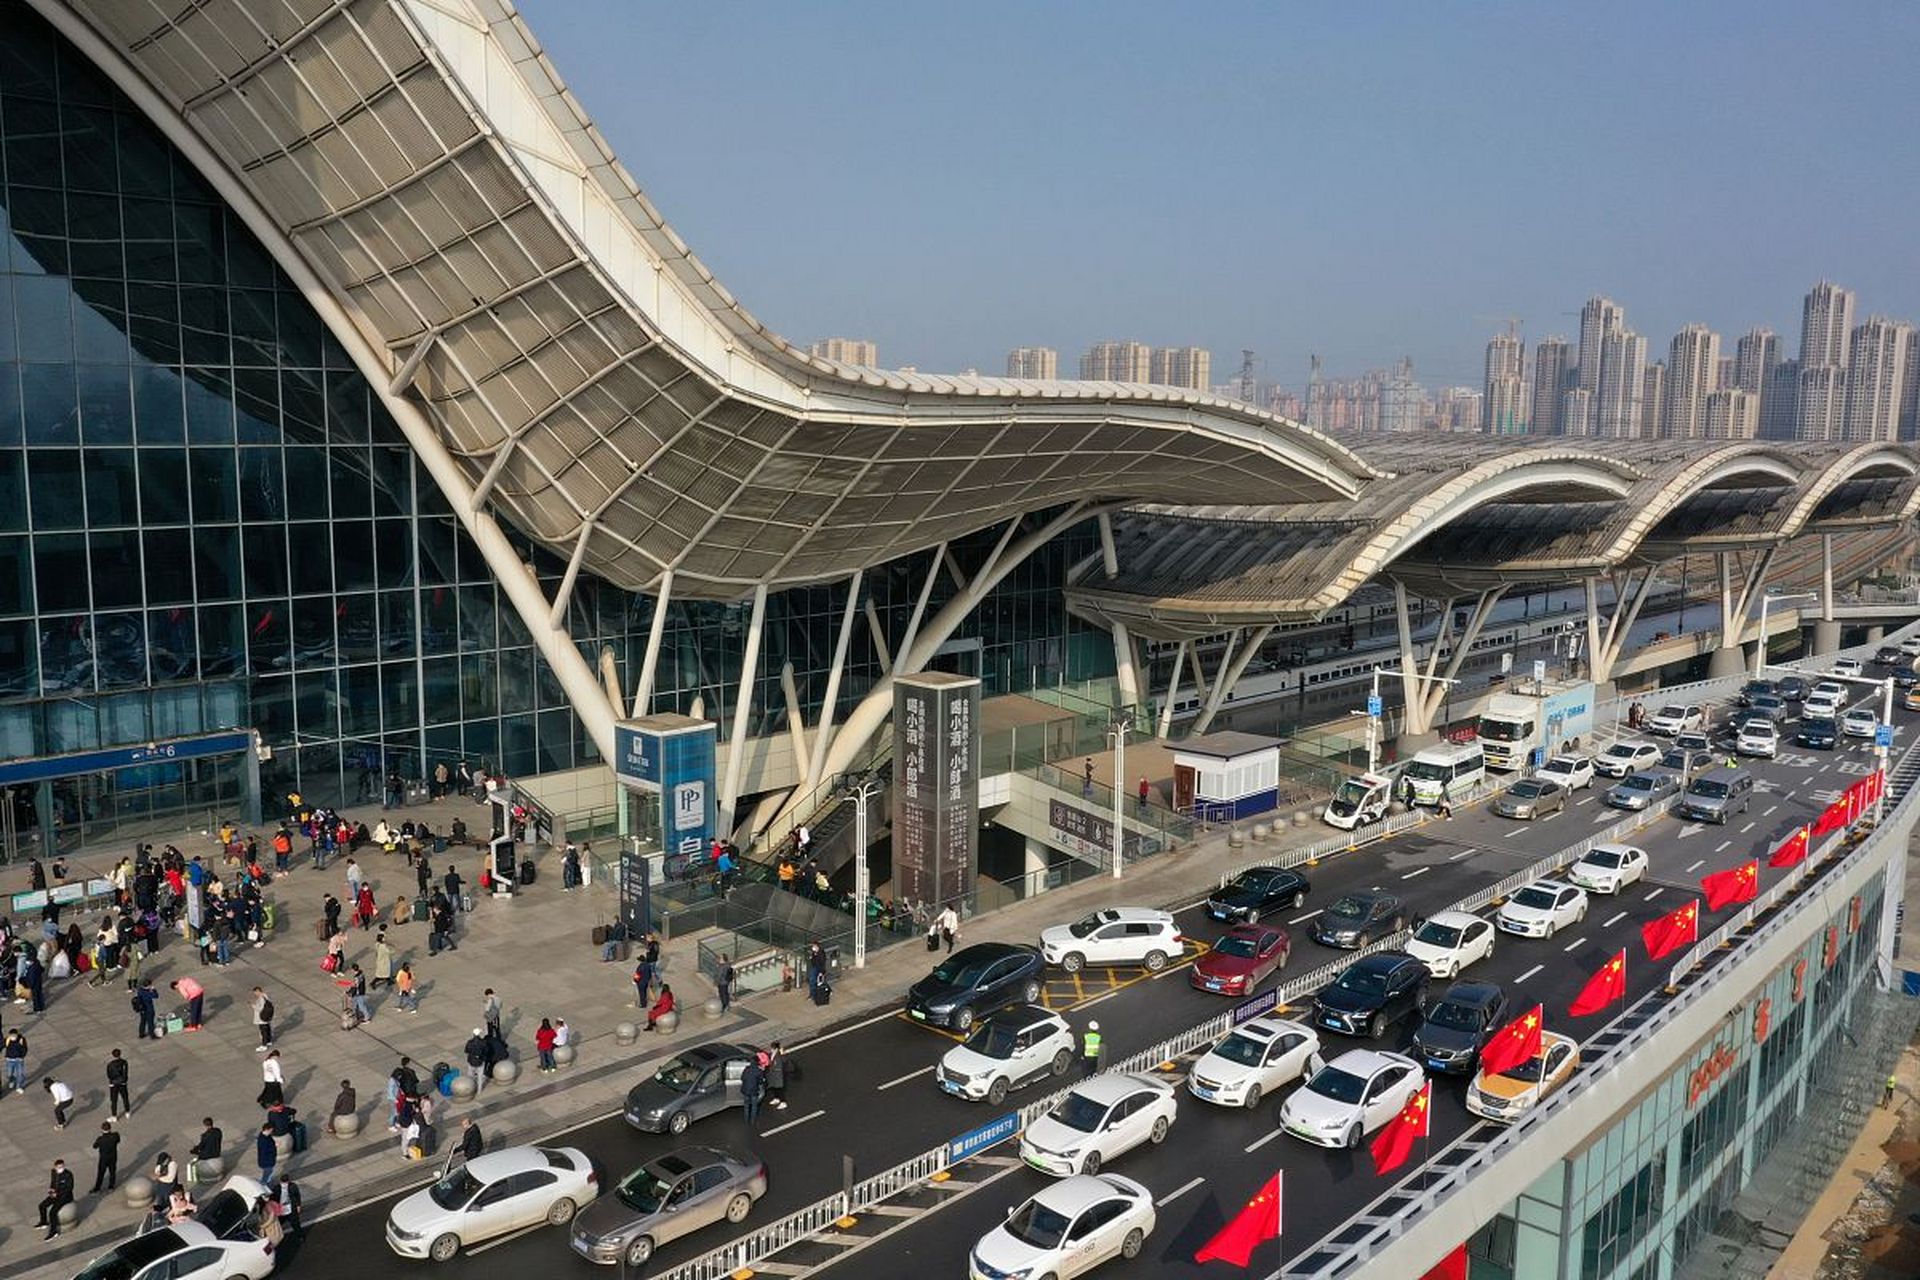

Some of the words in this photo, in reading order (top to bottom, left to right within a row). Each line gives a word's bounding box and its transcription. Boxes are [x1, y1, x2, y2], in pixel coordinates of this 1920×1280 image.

[167, 745, 176, 757] 6
[906, 751, 918, 799] 小郎酒
[950, 753, 962, 801] 小郎酒
